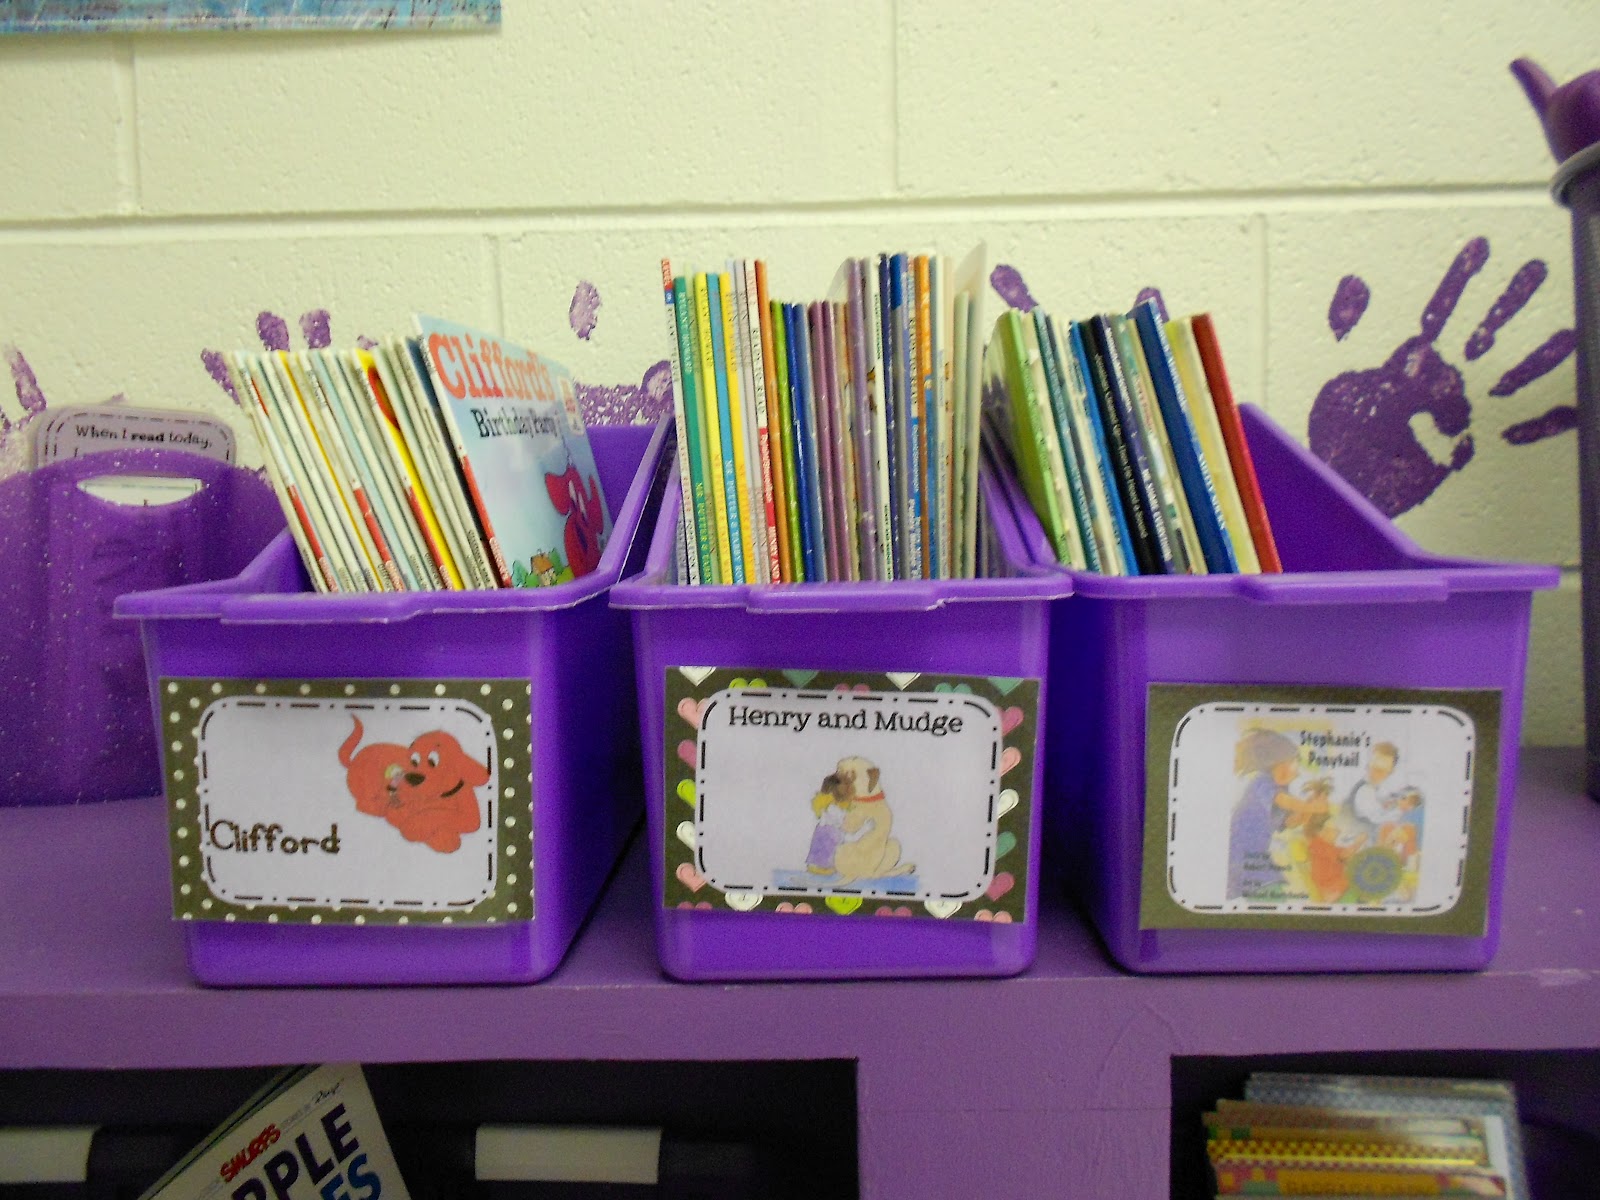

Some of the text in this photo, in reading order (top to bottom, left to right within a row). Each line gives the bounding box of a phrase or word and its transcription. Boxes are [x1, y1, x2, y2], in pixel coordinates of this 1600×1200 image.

[76, 423, 117, 440] When
[122, 427, 128, 439] I
[131, 431, 165, 442] read
[470, 407, 534, 438] Birthday
[729, 705, 964, 737] Henry and Mudge
[1308, 751, 1360, 769] Ponytail
[210, 819, 341, 854] Clifford
